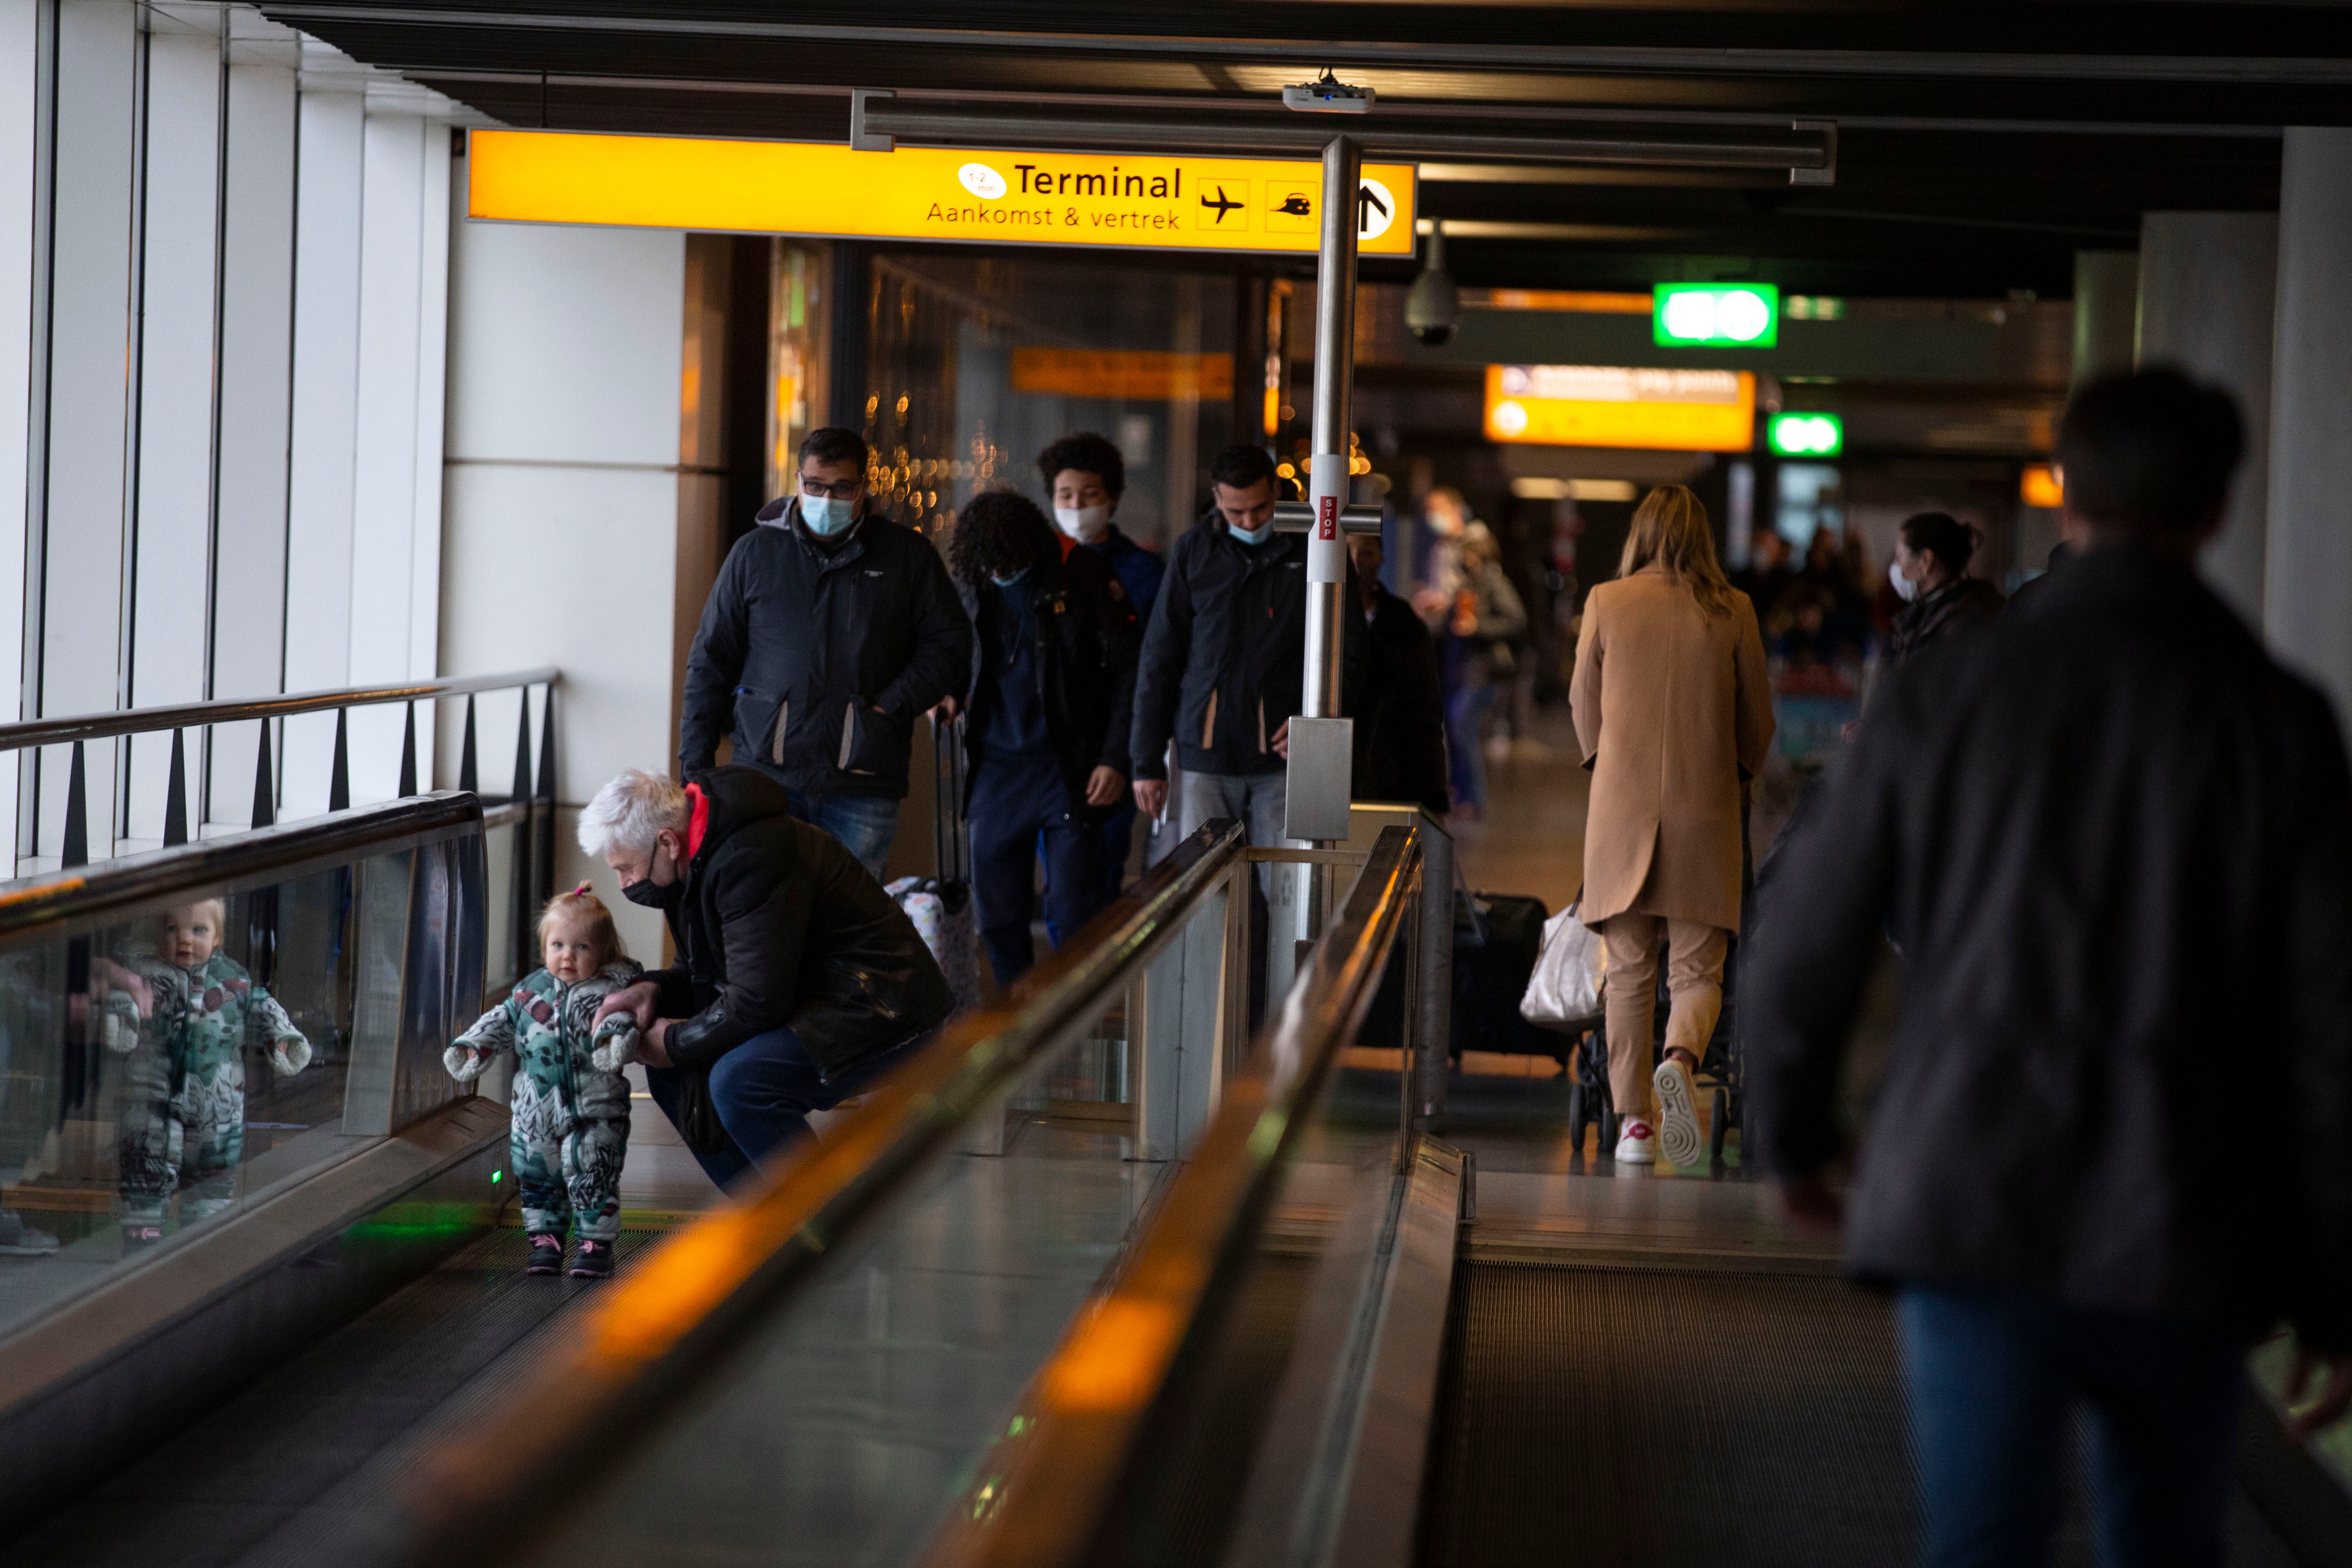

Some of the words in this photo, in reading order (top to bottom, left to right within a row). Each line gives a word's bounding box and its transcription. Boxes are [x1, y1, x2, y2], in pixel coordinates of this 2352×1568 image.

[1015, 164, 1180, 198] Terminal
[926, 203, 1053, 225] Aankomst
[1064, 207, 1079, 226] &
[1091, 210, 1179, 230] vertrek
